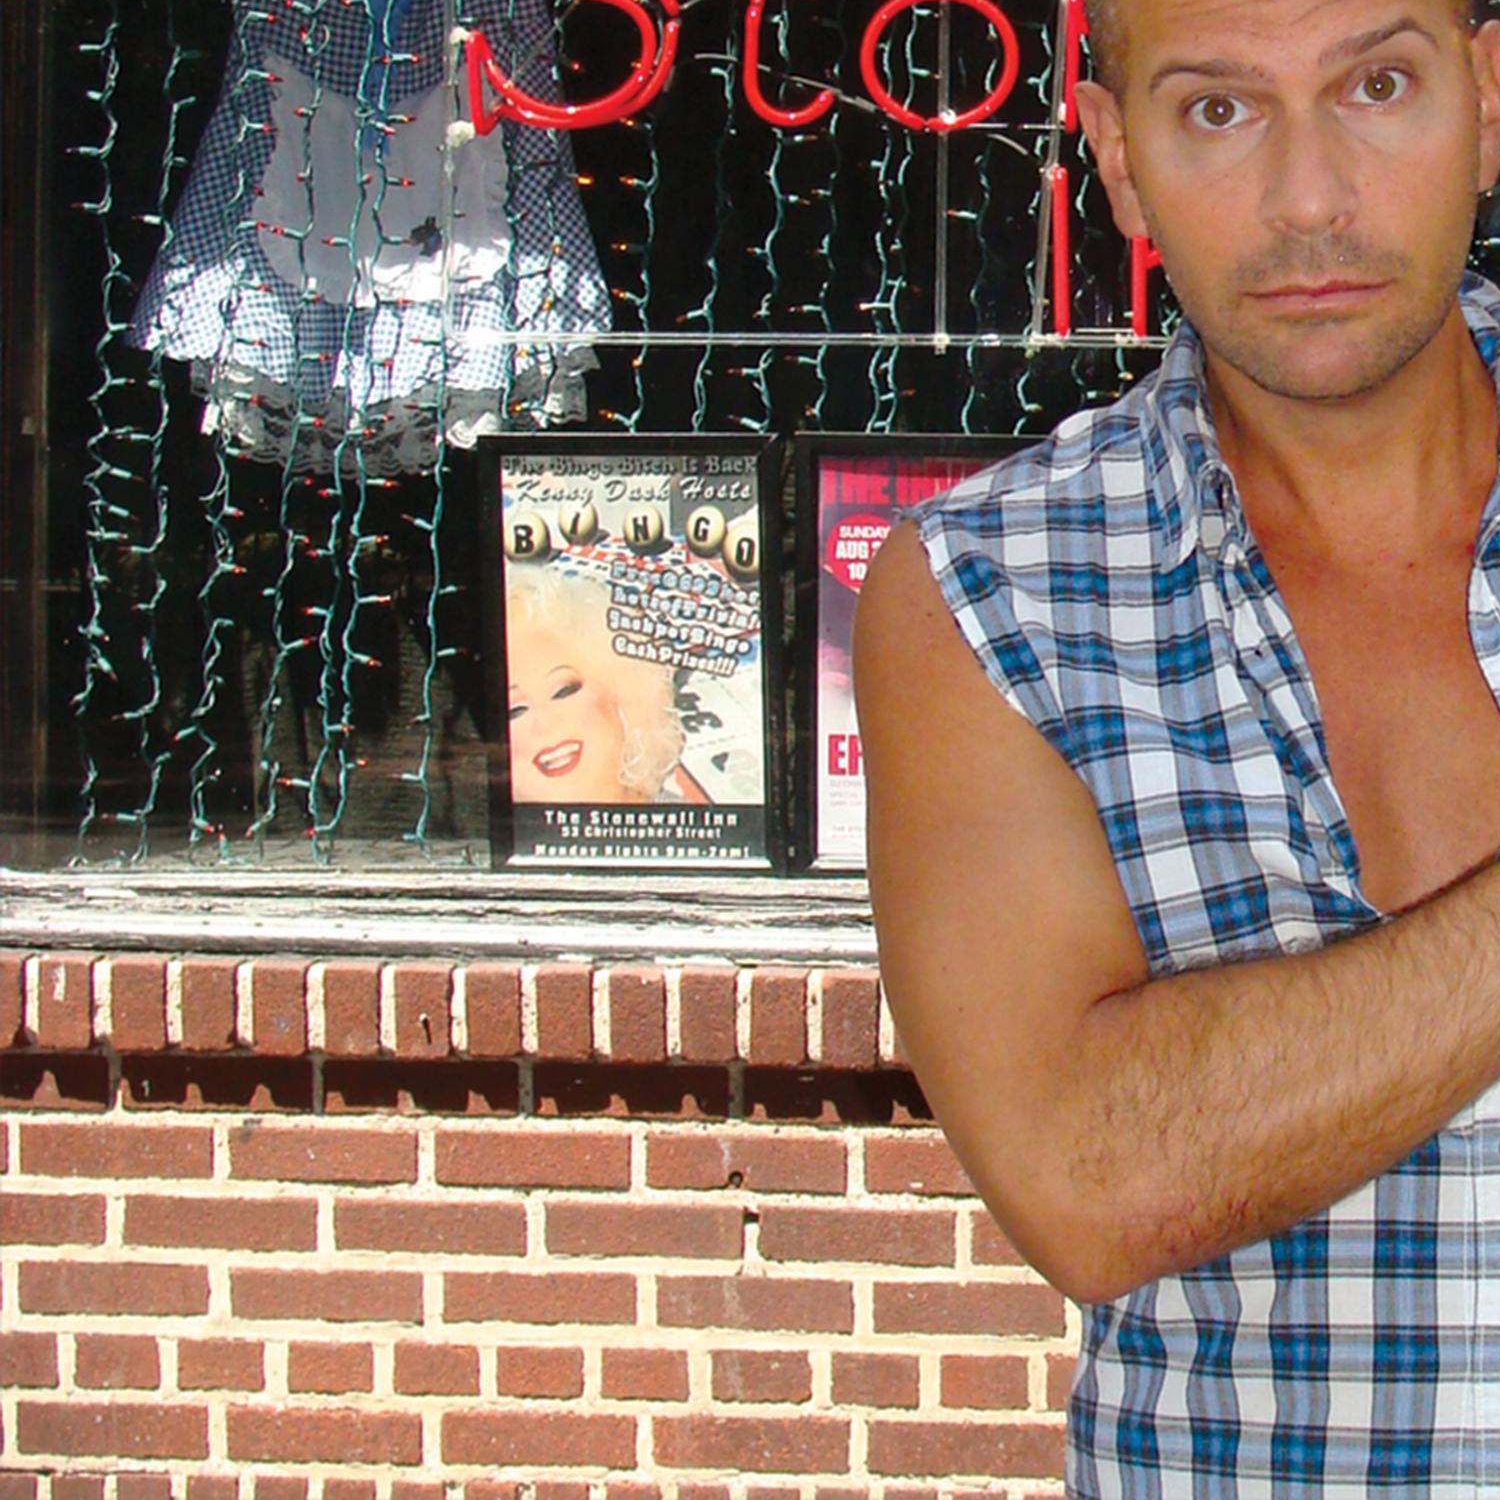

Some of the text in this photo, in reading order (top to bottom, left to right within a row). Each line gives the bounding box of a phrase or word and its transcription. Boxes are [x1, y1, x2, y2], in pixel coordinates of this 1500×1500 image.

[839, 525, 891, 539] SUNDAY
[836, 541, 868, 560] AUG
[545, 810, 738, 826] The Stonewall Inn
[584, 826, 672, 839] Christopher
[675, 826, 721, 838] Street
